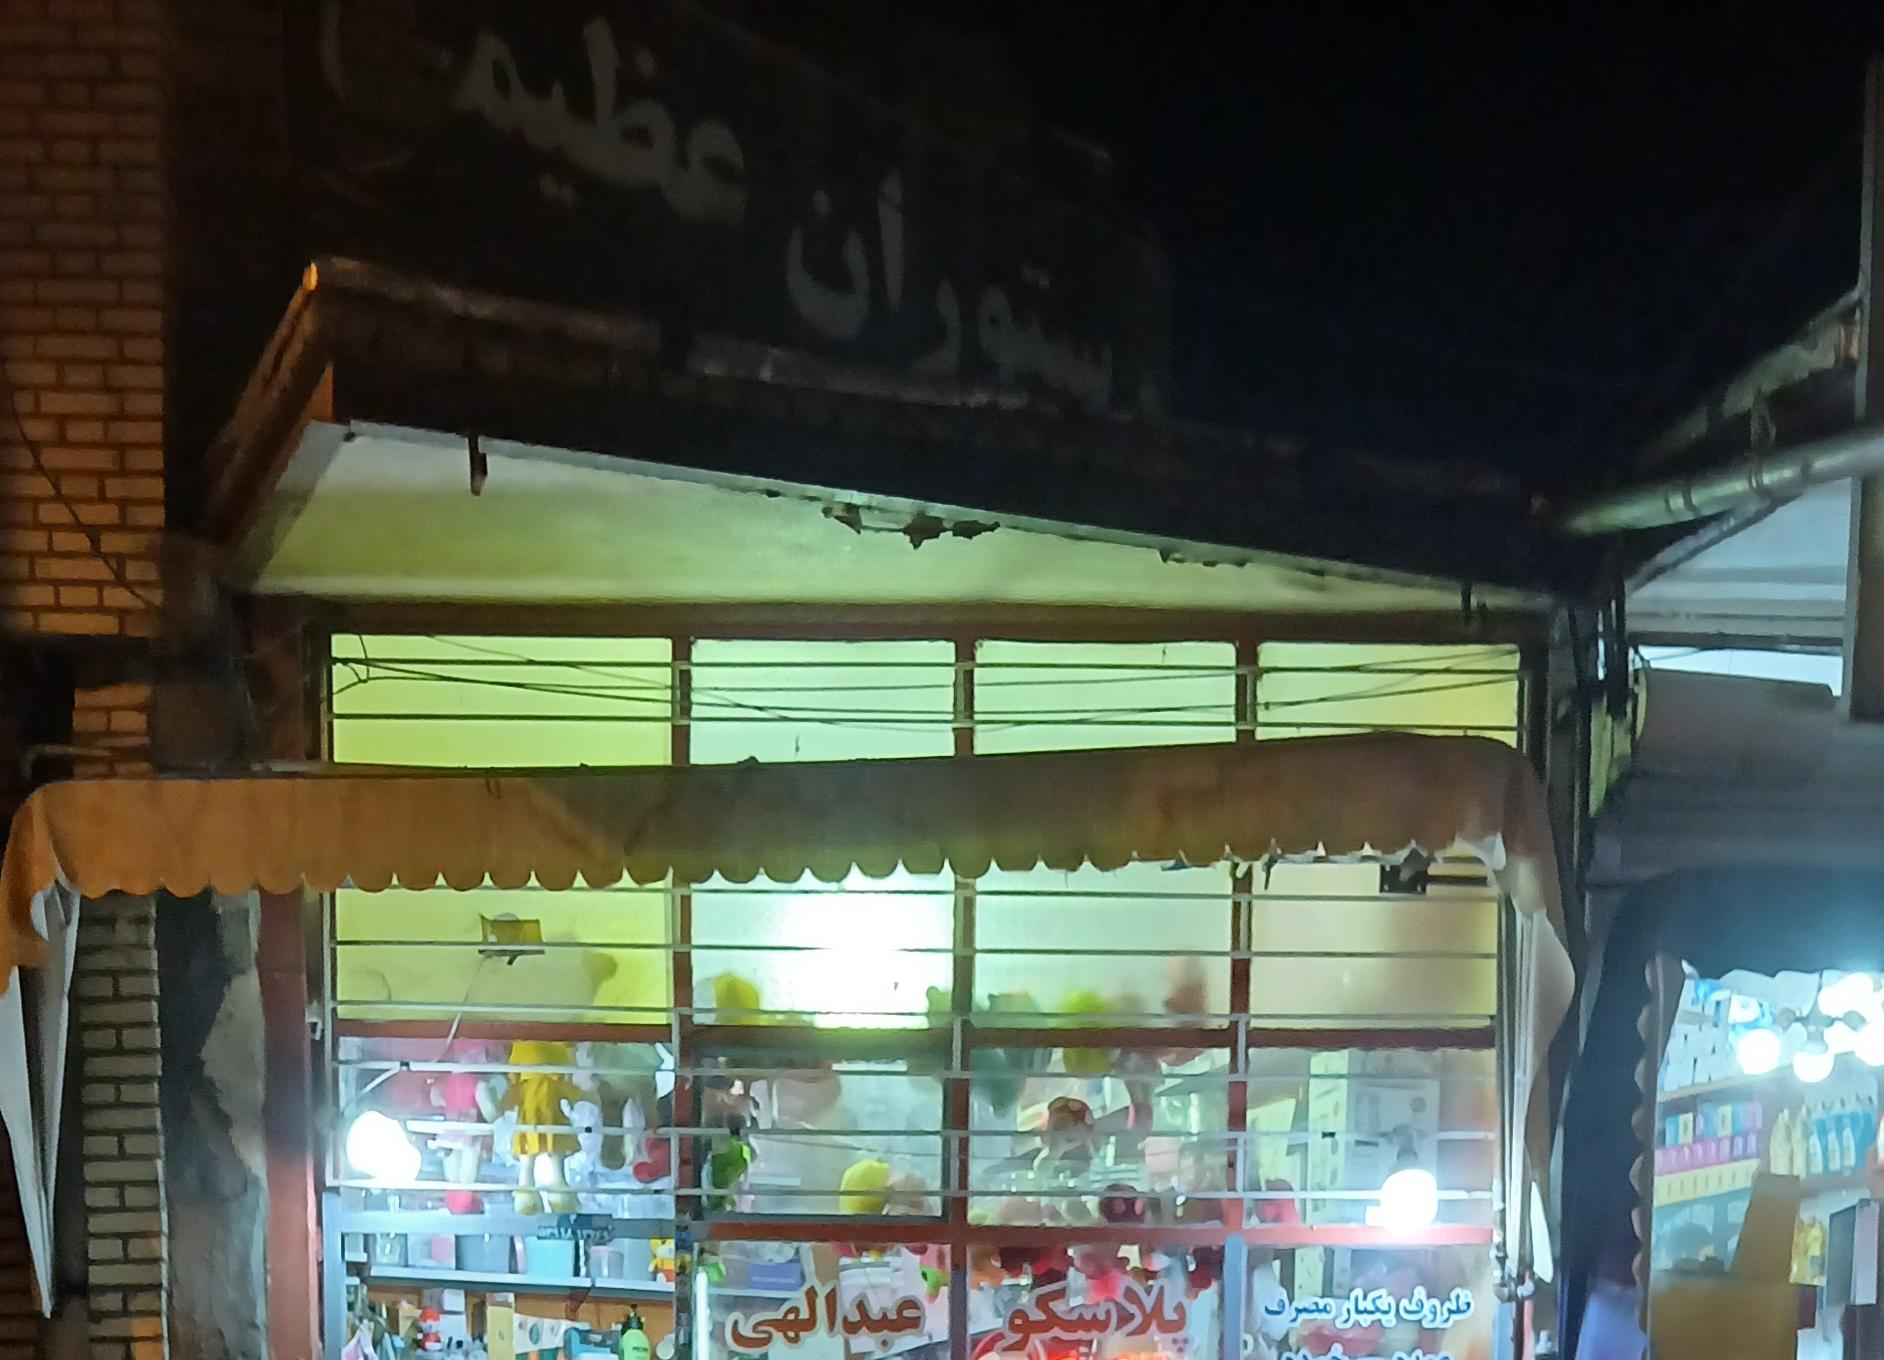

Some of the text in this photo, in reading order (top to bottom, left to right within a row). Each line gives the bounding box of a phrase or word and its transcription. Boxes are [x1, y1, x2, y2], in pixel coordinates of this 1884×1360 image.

[731, 1285, 922, 1348] عبدالهی
[1001, 1283, 1189, 1353] پلاسکو
[1264, 1287, 1472, 1327] ظروف یکبار مصرف
